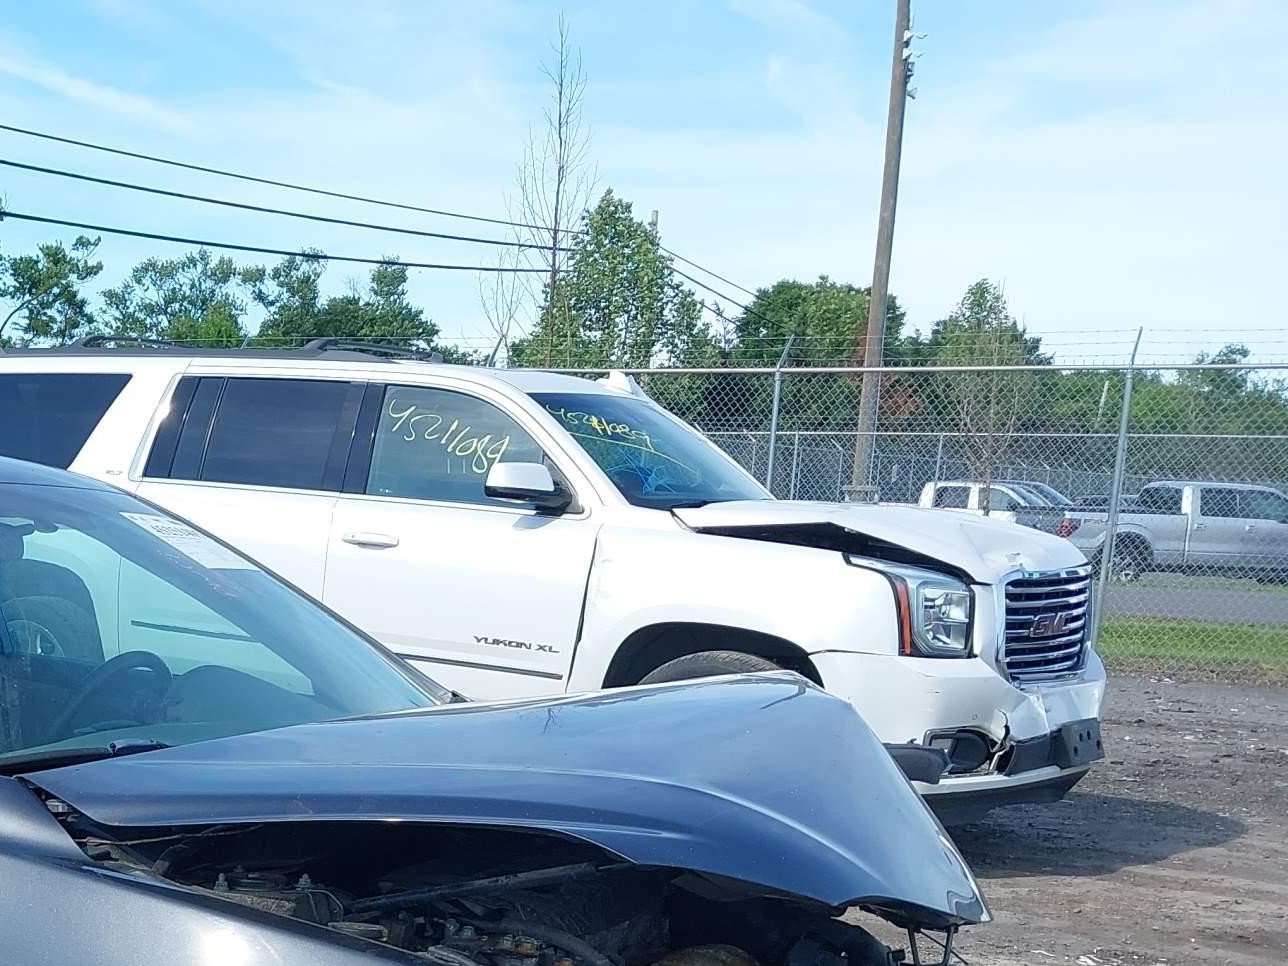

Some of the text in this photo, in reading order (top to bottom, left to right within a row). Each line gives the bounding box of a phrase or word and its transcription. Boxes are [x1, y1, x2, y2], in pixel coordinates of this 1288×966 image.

[388, 399, 510, 473] 45211089
[472, 634, 560, 653] YUKON XL
